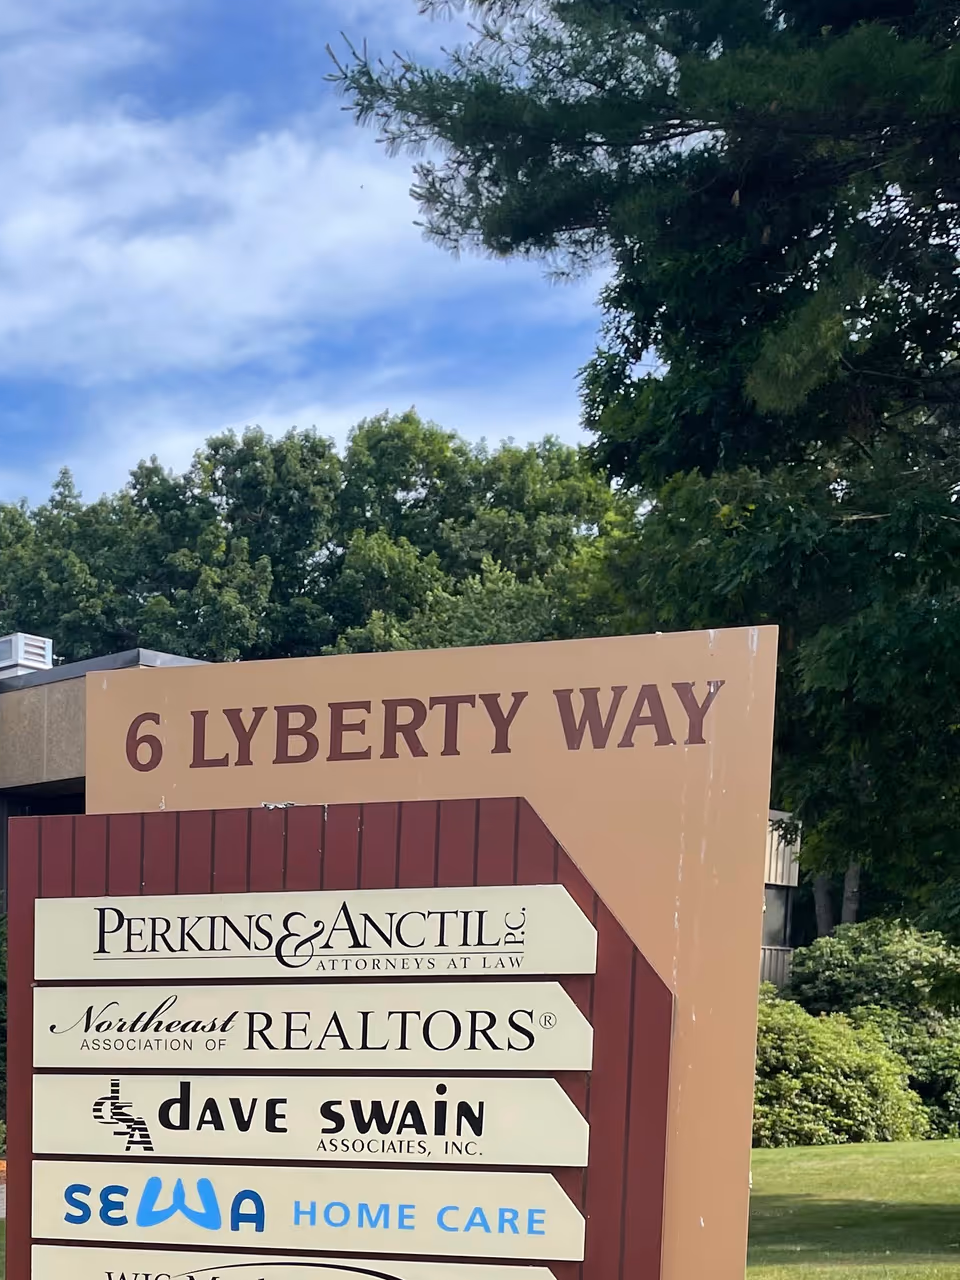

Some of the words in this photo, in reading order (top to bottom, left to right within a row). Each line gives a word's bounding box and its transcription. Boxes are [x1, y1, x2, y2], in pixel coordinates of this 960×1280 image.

[126, 713, 162, 772] 6
[190, 692, 528, 768] LYBERTY
[553, 681, 725, 750] WAY
[504, 907, 527, 946] P.C.
[316, 958, 435, 970] ATTORNEYS
[447, 957, 470, 969] AT
[481, 953, 524, 968] LAW
[49, 994, 239, 1034] Northeast
[80, 1039, 192, 1050] ASSOCIATION
[205, 1039, 226, 1051] OF
[317, 1138, 431, 1157] ASSOCIATES,
[445, 1141, 482, 1155] INC.
[64, 1177, 265, 1232] SEWA
[295, 1201, 415, 1229] HOME
[437, 1206, 545, 1234] CARE
